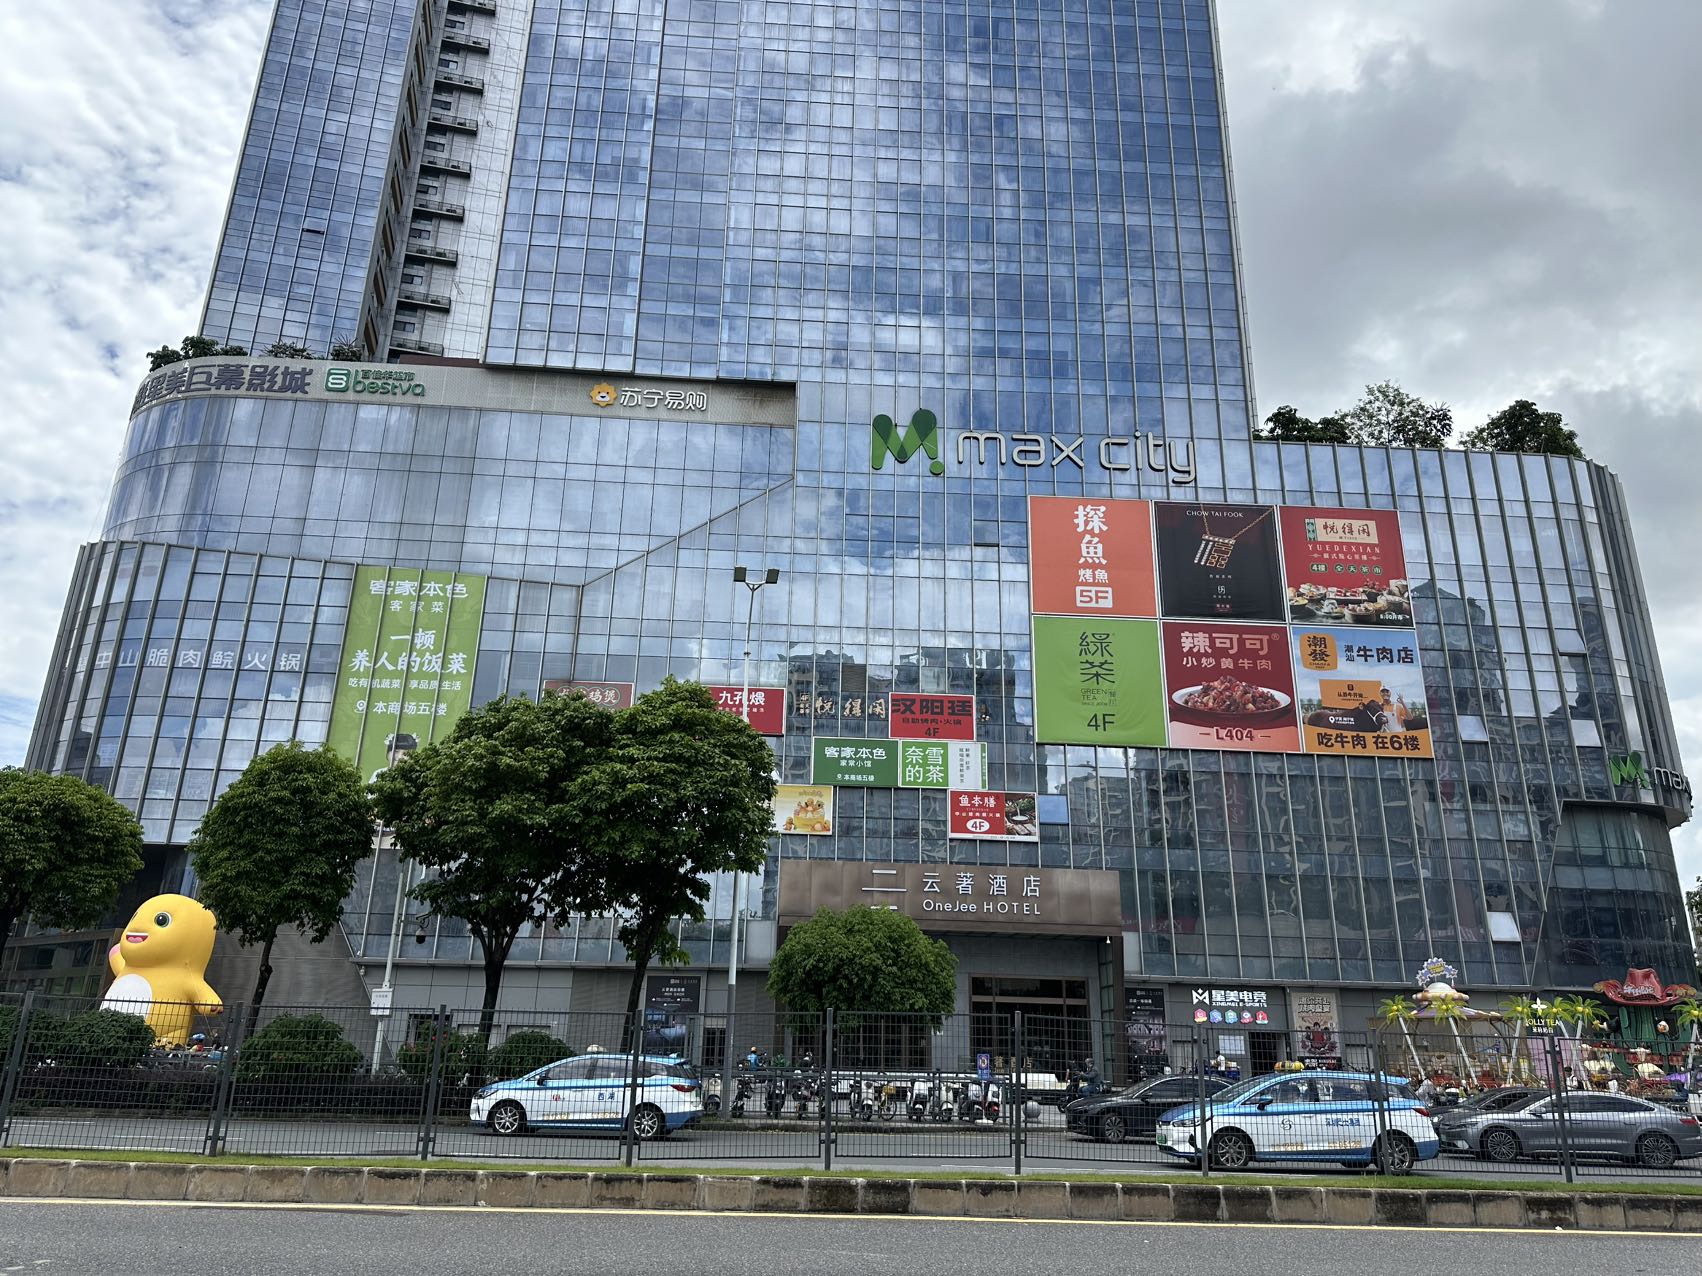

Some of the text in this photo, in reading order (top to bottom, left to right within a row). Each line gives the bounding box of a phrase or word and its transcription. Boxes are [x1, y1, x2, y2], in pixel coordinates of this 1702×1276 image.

[352, 370, 425, 396] bestva
[620, 387, 707, 411] 苏宁易购
[957, 431, 1196, 483] max city
[1307, 544, 1380, 553] YUEDEXIAN
[1078, 568, 1109, 583] 烤魚
[369, 580, 468, 598] 客家本色
[1079, 589, 1109, 604] 5F
[389, 600, 444, 613] 客家菜
[390, 628, 436, 650] 一顿
[1181, 631, 1270, 656] 辣可可
[94, 648, 301, 671] 中山脆肉鲩火锅
[348, 648, 467, 675] 养人的饭菜
[1182, 656, 1272, 671] 小炒黄牛肉
[1356, 645, 1414, 664] 牛肉店
[348, 677, 401, 688] 吃有机蔬菜
[373, 701, 448, 716] 本商场五楼
[1087, 713, 1115, 732] 4F
[924, 728, 940, 737] 4F
[1215, 728, 1254, 741] L404
[1316, 732, 1421, 752] 吃牛肉 在6楼
[824, 746, 887, 760] 客家本色
[905, 746, 944, 765] 奈雪
[905, 765, 945, 783] 的茶
[971, 821, 985, 831] 4F
[922, 872, 1041, 898] 云著酒店
[922, 900, 1041, 915] OneJee HOTEL
[1211, 989, 1267, 1003] 星美电竞
